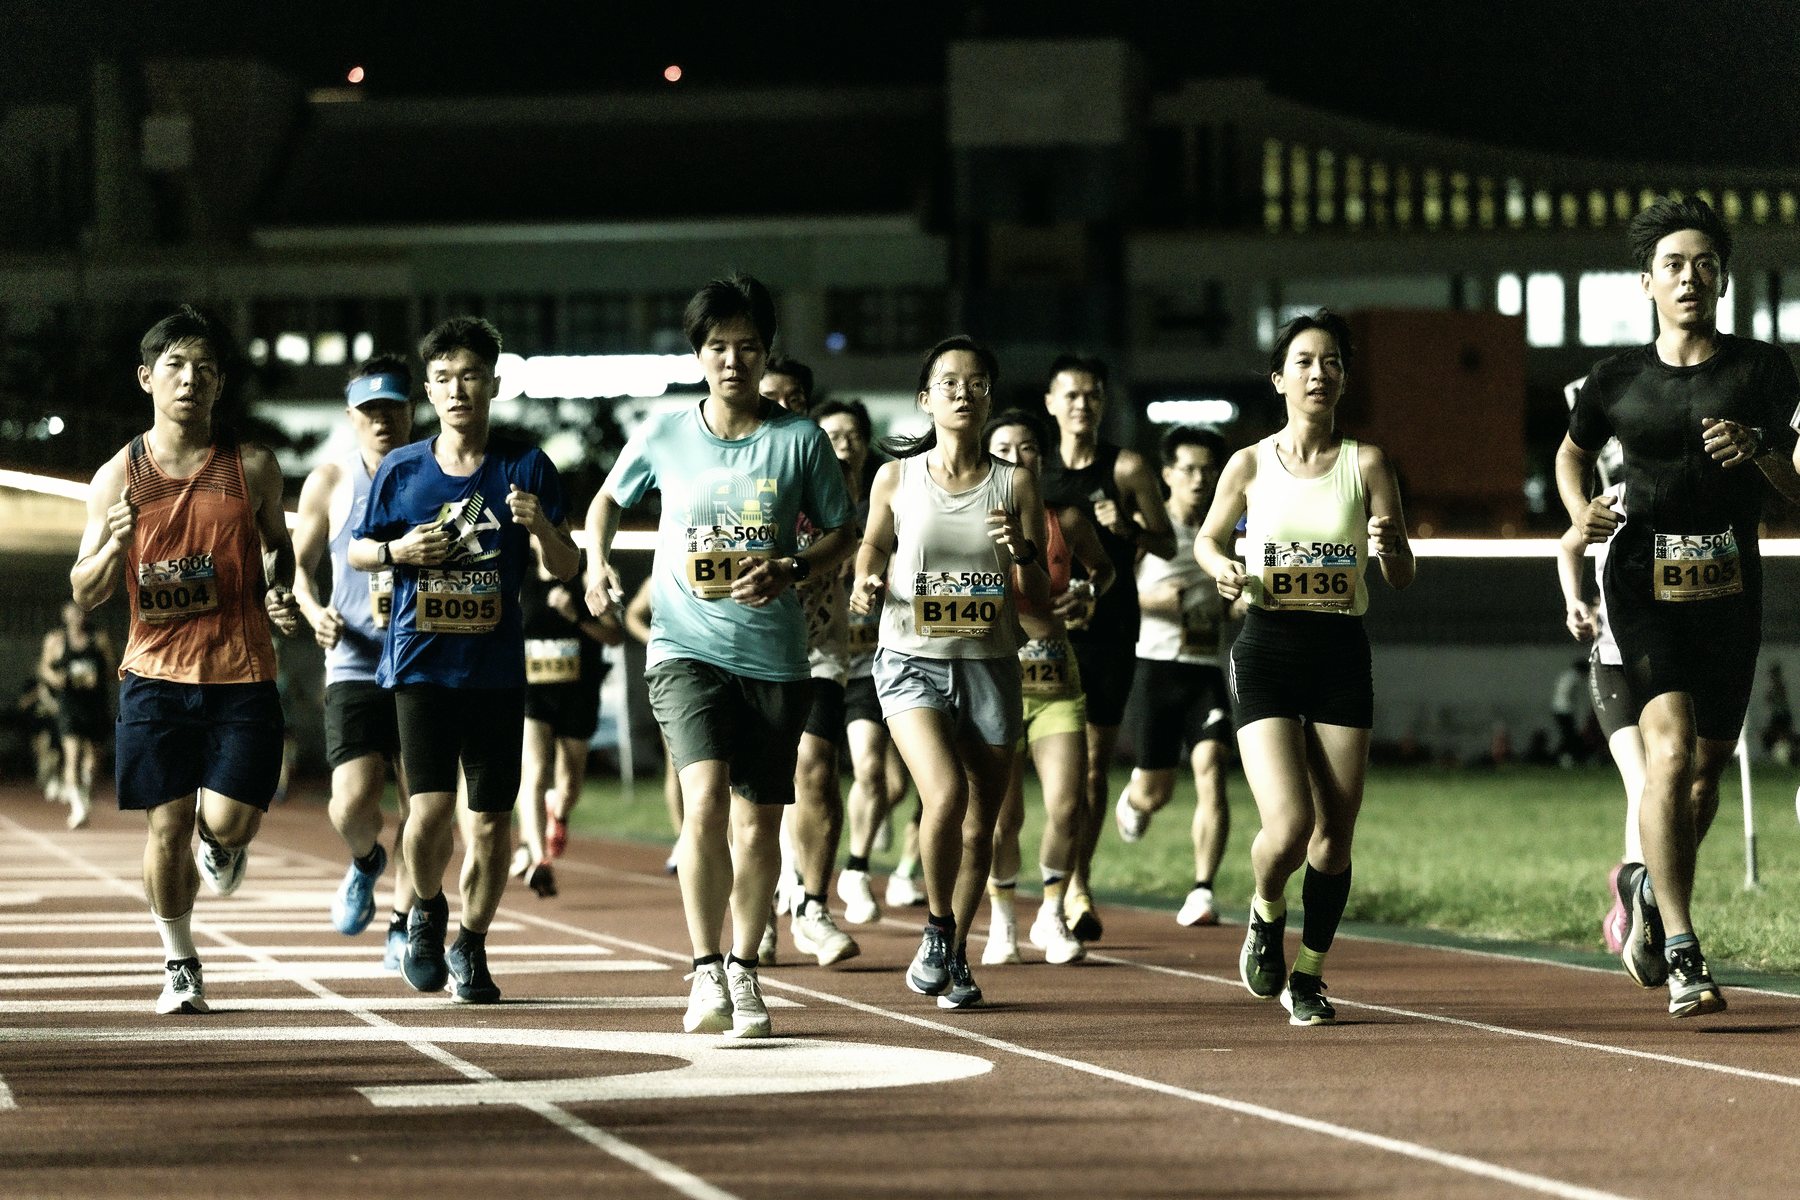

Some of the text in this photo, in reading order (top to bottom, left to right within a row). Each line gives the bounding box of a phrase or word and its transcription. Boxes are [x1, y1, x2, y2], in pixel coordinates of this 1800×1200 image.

[1264, 543, 1277, 567] 高雄
[1311, 543, 1357, 557] 5000
[916, 572, 927, 596] 高雄
[960, 572, 1004, 587] 5000
[1273, 573, 1348, 594] B136
[140, 586, 210, 610] B004
[425, 598, 495, 619] B095
[923, 601, 996, 622] B140
